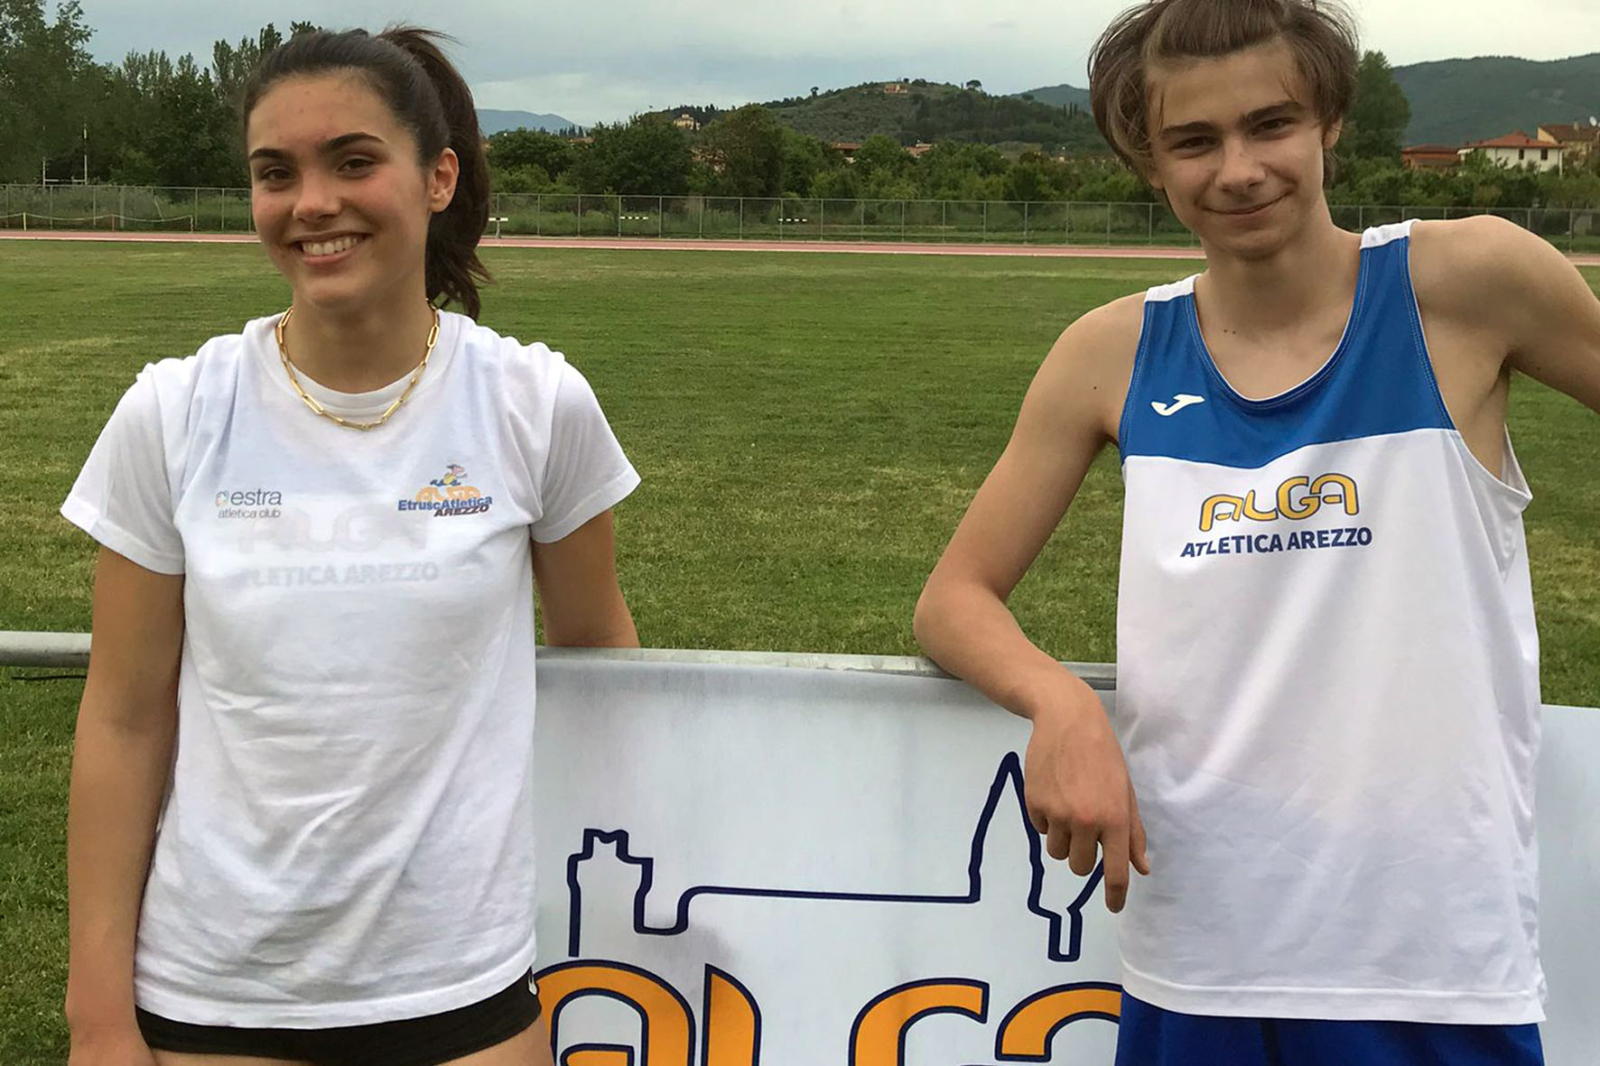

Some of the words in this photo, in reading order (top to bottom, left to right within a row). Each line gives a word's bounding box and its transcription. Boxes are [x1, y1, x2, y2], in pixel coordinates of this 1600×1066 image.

[230, 488, 283, 506] estra
[397, 495, 493, 511] EtruscAtletica
[1199, 473, 1359, 532] ALGA
[218, 508, 257, 519] atletica
[259, 507, 282, 519] club
[433, 503, 489, 517] AREZZO
[1180, 534, 1283, 558] ATLETICA
[1286, 526, 1373, 551] AREZZO
